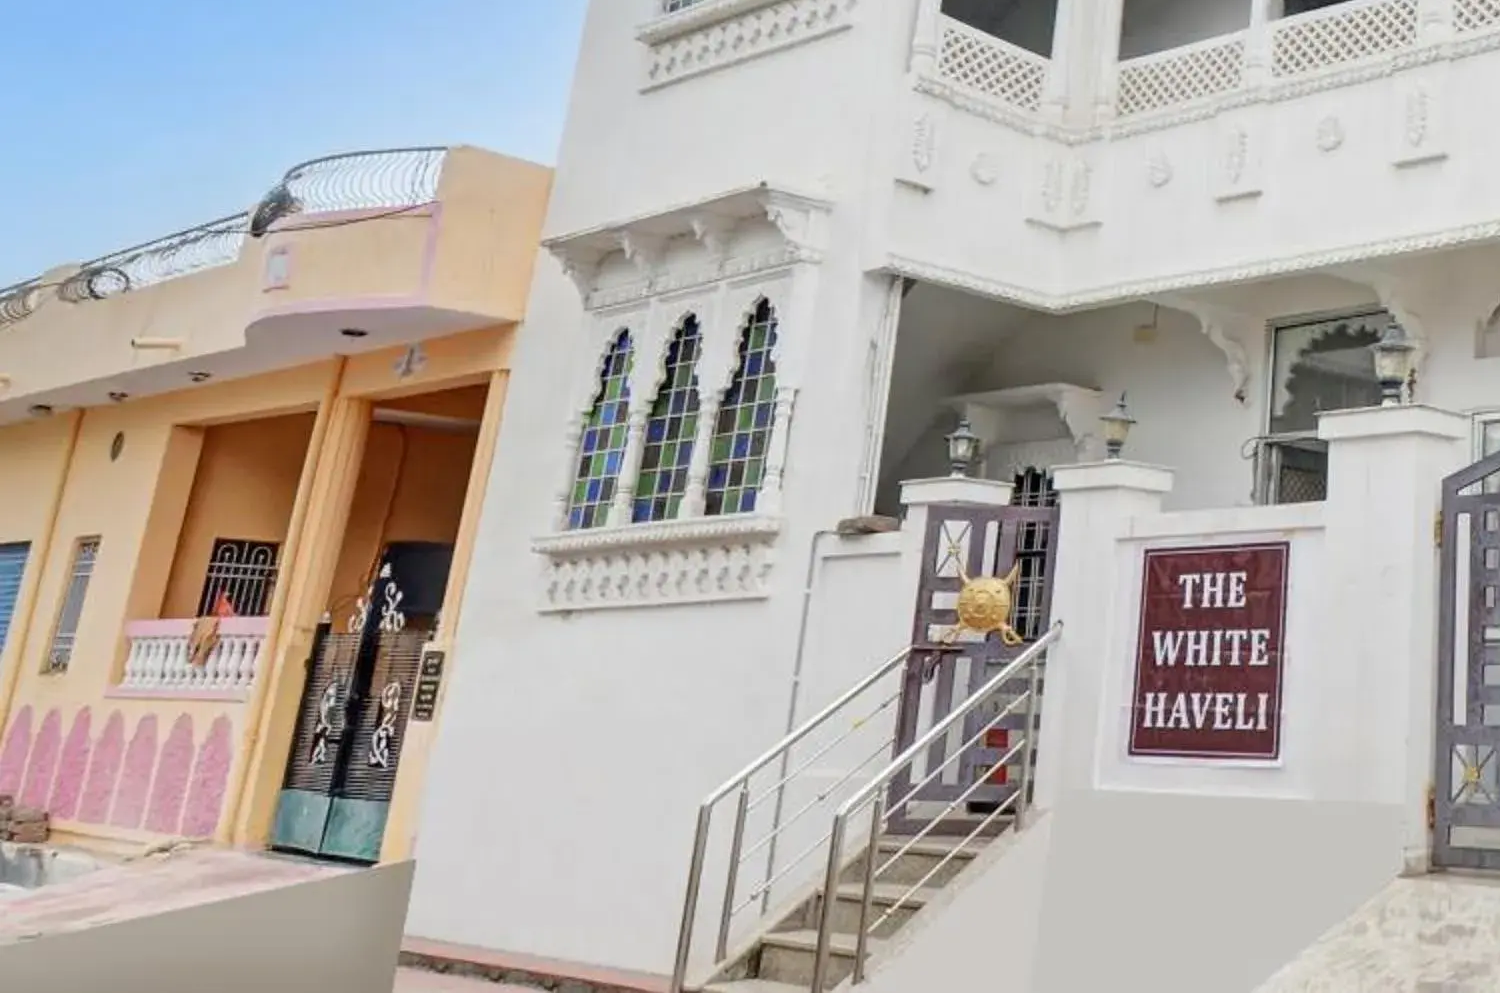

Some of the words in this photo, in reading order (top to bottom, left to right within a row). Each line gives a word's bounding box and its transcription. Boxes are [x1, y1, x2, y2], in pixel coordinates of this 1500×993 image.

[1179, 571, 1247, 609] THE
[1152, 628, 1270, 666] WHITE
[1143, 691, 1269, 730] HAVELI
